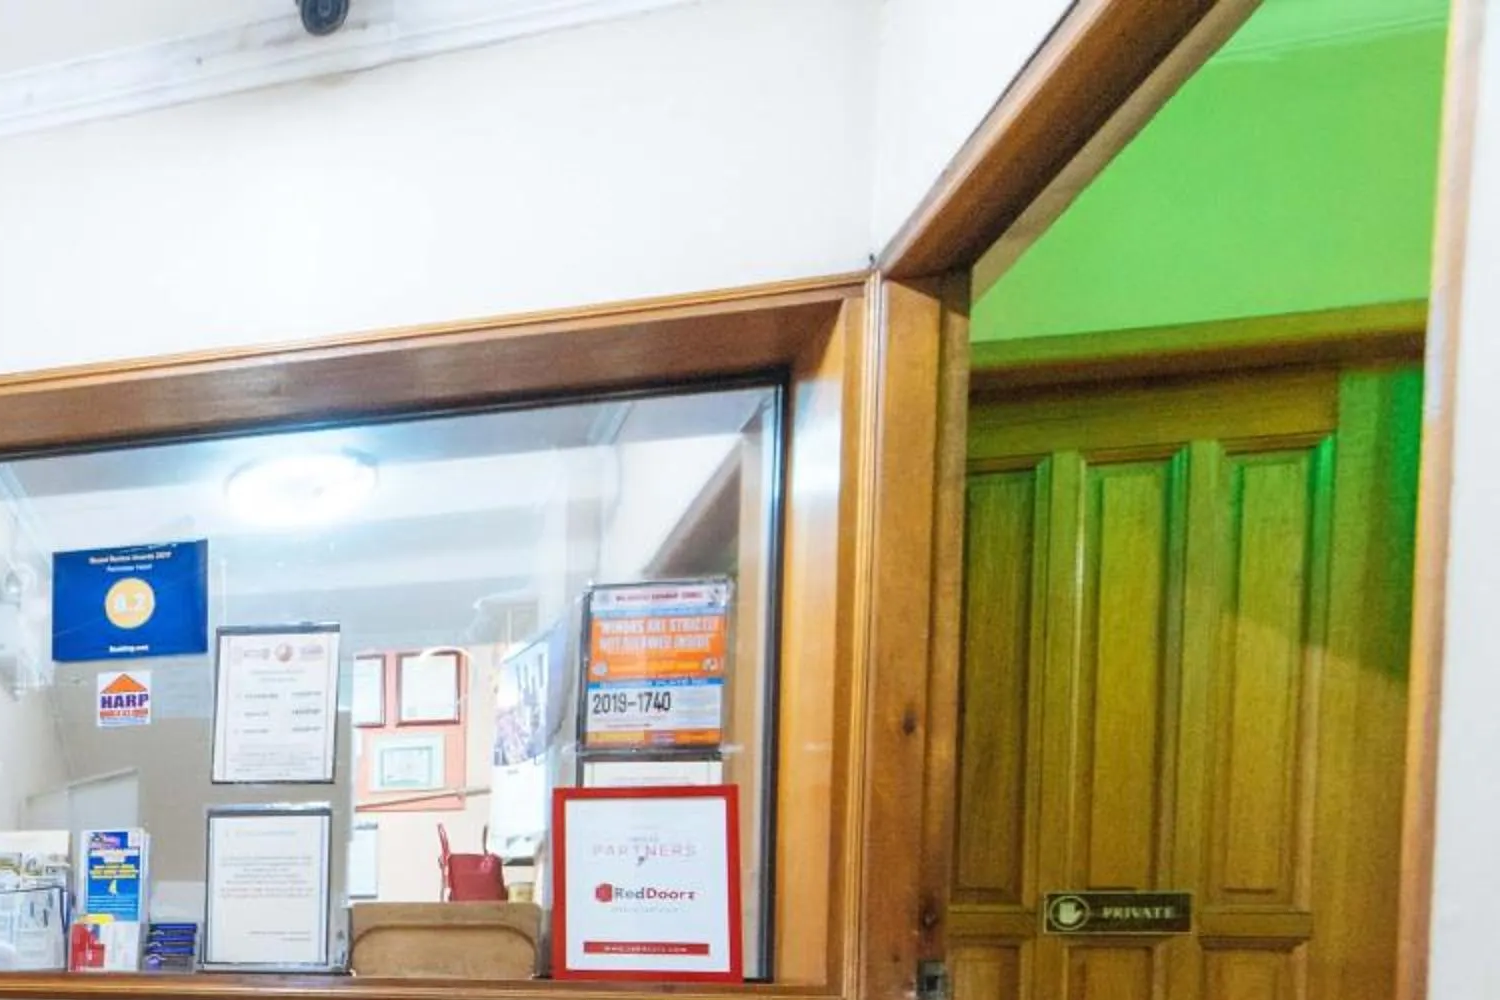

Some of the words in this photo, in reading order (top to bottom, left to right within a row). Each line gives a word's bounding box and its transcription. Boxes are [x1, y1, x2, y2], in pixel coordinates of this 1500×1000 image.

[100, 693, 149, 709] HARP
[592, 691, 672, 715] 2019-1740
[614, 886, 696, 901] RedDoorz
[1102, 906, 1173, 919] PRIVATE
